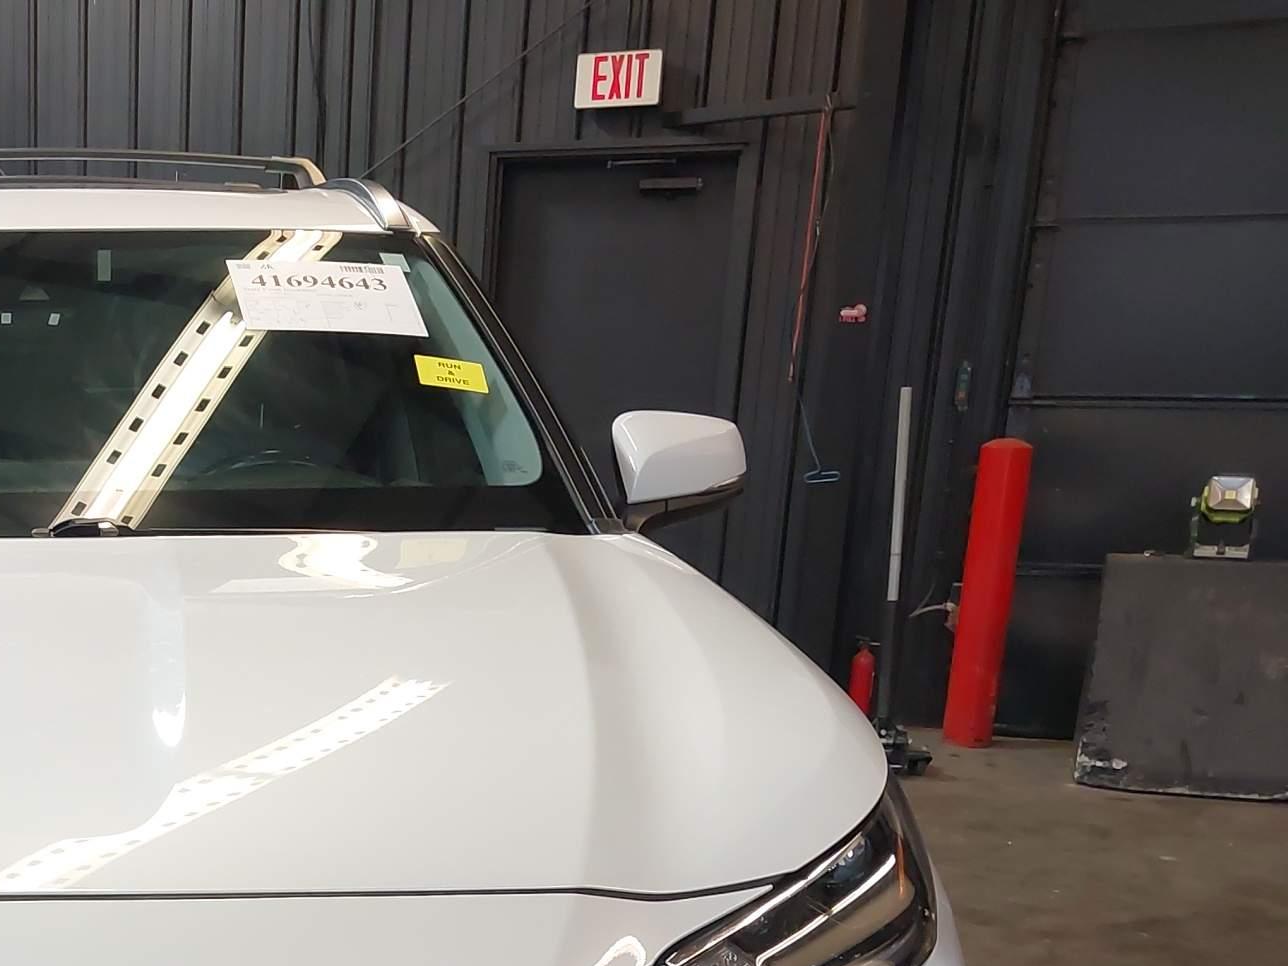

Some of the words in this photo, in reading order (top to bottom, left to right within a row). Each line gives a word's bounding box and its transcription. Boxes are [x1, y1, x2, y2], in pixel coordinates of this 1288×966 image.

[591, 52, 650, 101] EXIT
[251, 273, 388, 291] 41694643
[437, 361, 462, 370] RUN
[436, 375, 470, 386] DRIVE
